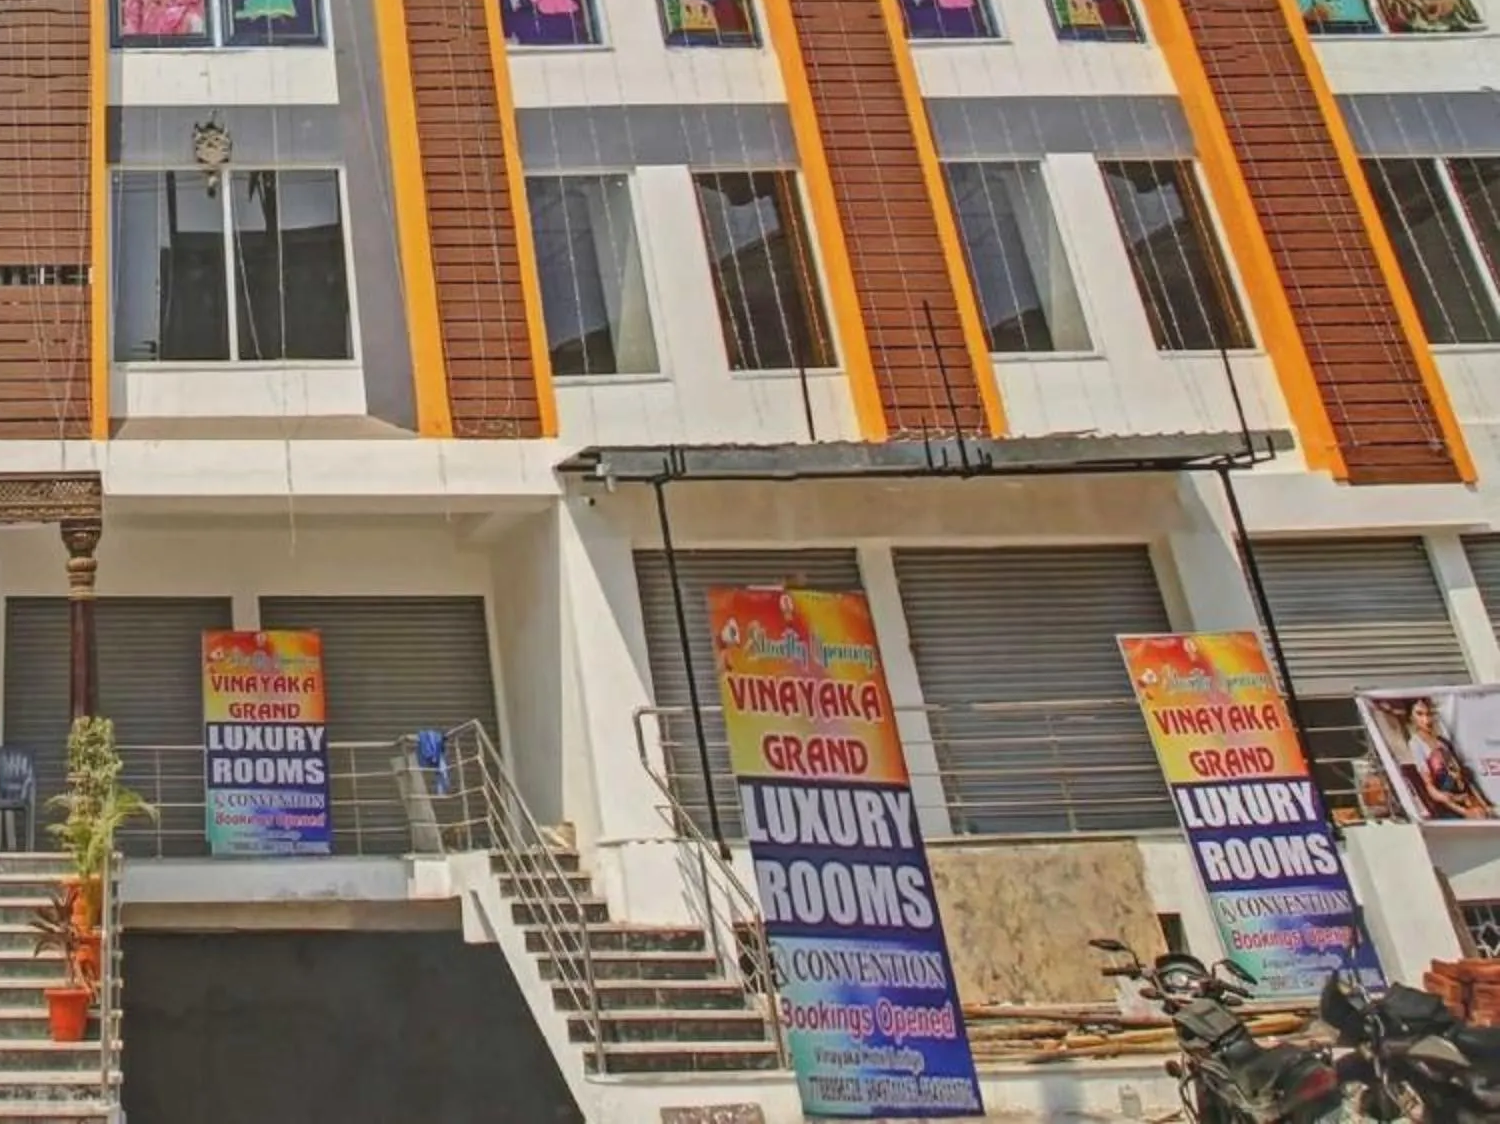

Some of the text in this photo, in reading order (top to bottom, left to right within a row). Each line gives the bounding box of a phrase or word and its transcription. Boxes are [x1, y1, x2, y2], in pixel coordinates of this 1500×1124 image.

[211, 675, 315, 694] VINAYAKA
[727, 677, 881, 720] VINAYAKA
[229, 703, 301, 720] GRAND
[1152, 704, 1281, 735] VINAYAKA
[208, 725, 325, 752] LUXURY
[763, 734, 869, 775] GRAND
[212, 757, 325, 785] ROOMS
[1188, 747, 1275, 777] GRAND
[740, 783, 914, 849] LUXURY
[1176, 781, 1317, 827] LUXURY
[1198, 834, 1340, 882] ROOMS
[755, 859, 934, 929] ROOMS
[792, 946, 946, 988] CONVENTION
[780, 997, 957, 1043] Bookings Opened
